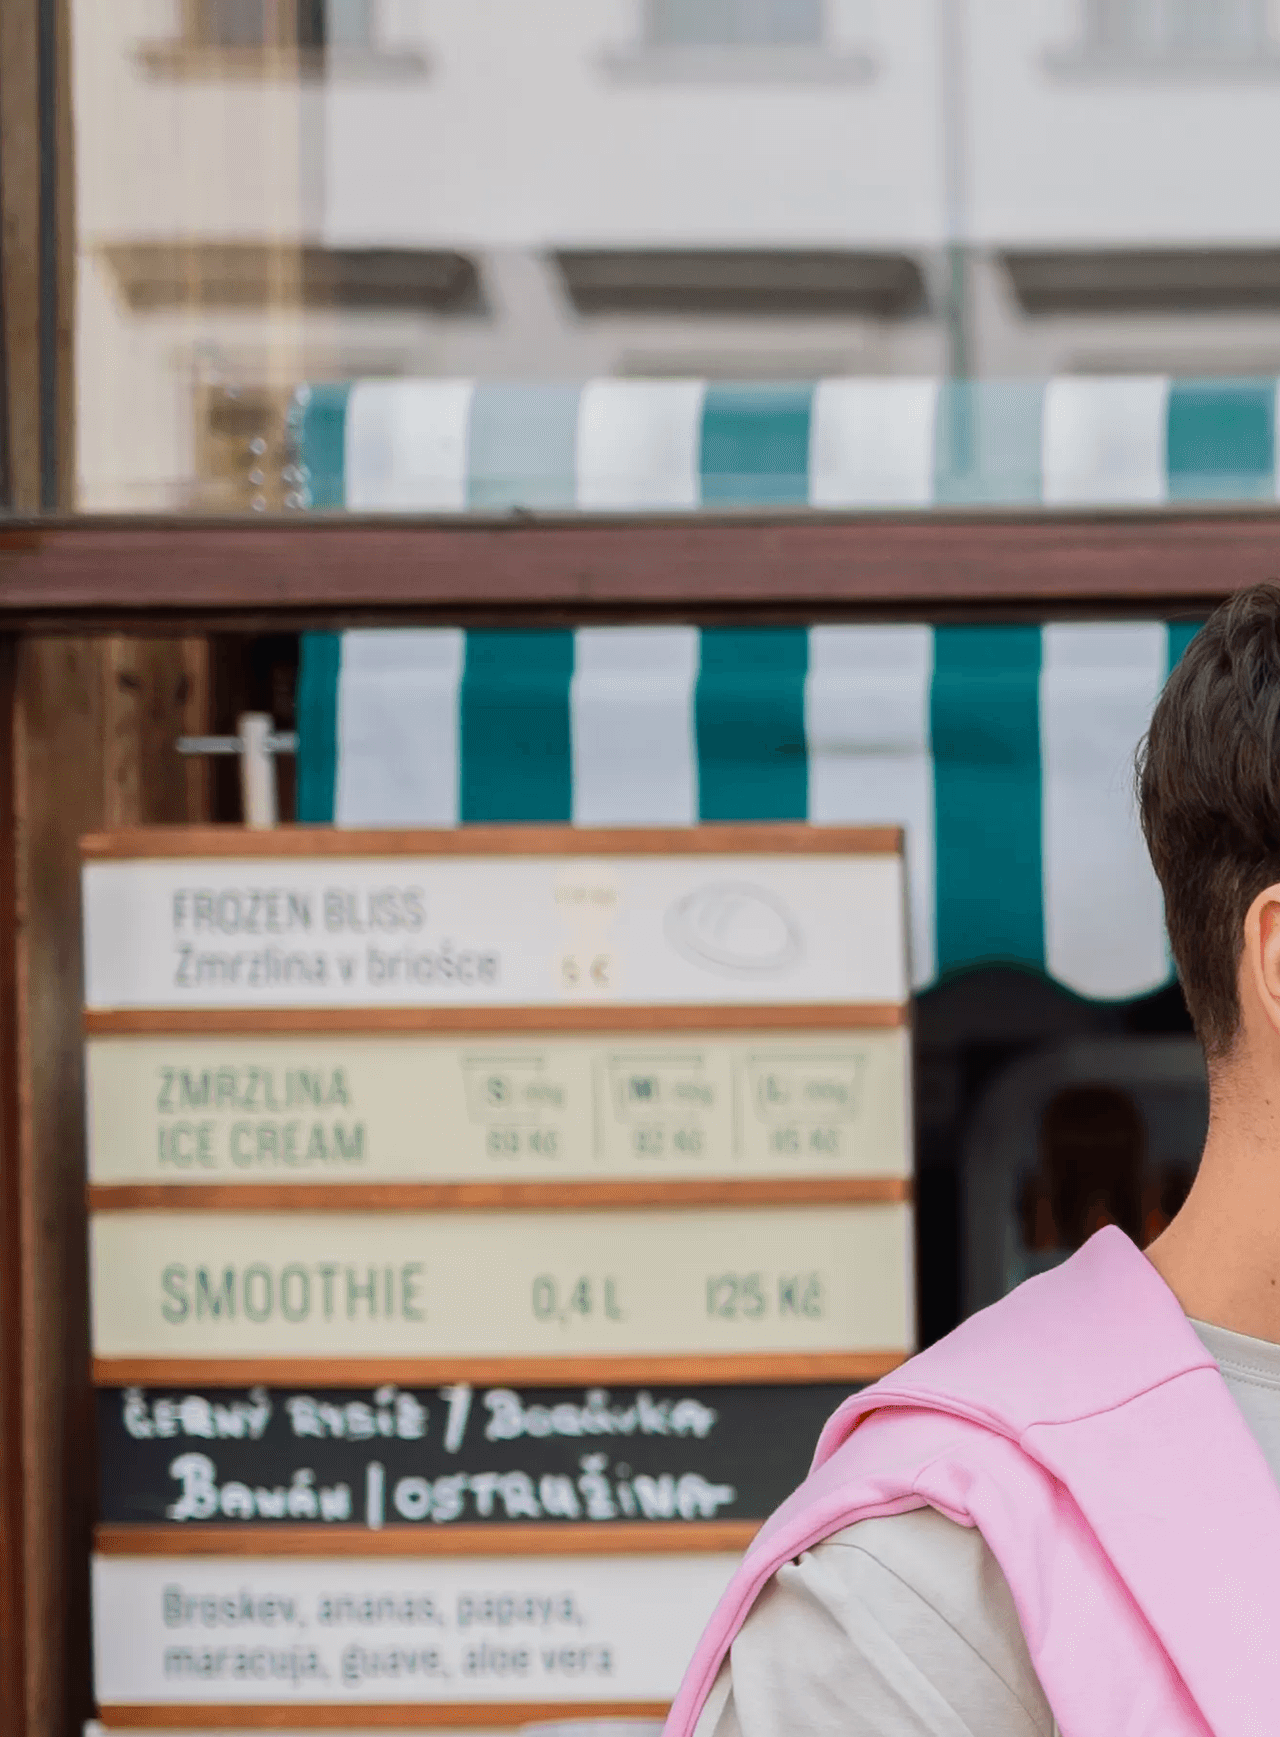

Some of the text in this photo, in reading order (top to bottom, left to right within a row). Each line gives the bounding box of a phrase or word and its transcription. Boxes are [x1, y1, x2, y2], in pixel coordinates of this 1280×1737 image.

[172, 885, 425, 933] FROZEN BLISS
[175, 942, 326, 986] Zmrzlina
[339, 955, 354, 985] v
[157, 1066, 351, 1111] ZMRZLINA
[157, 1119, 365, 1165] ICE CREAM
[161, 1261, 426, 1325] SMOOTHIE
[530, 1274, 593, 1330] 0,4
[603, 1275, 628, 1321] L
[705, 1271, 767, 1321] 125
[162, 1583, 586, 1631] Broskev, ananas, papaya,
[541, 1646, 615, 1677] vera
